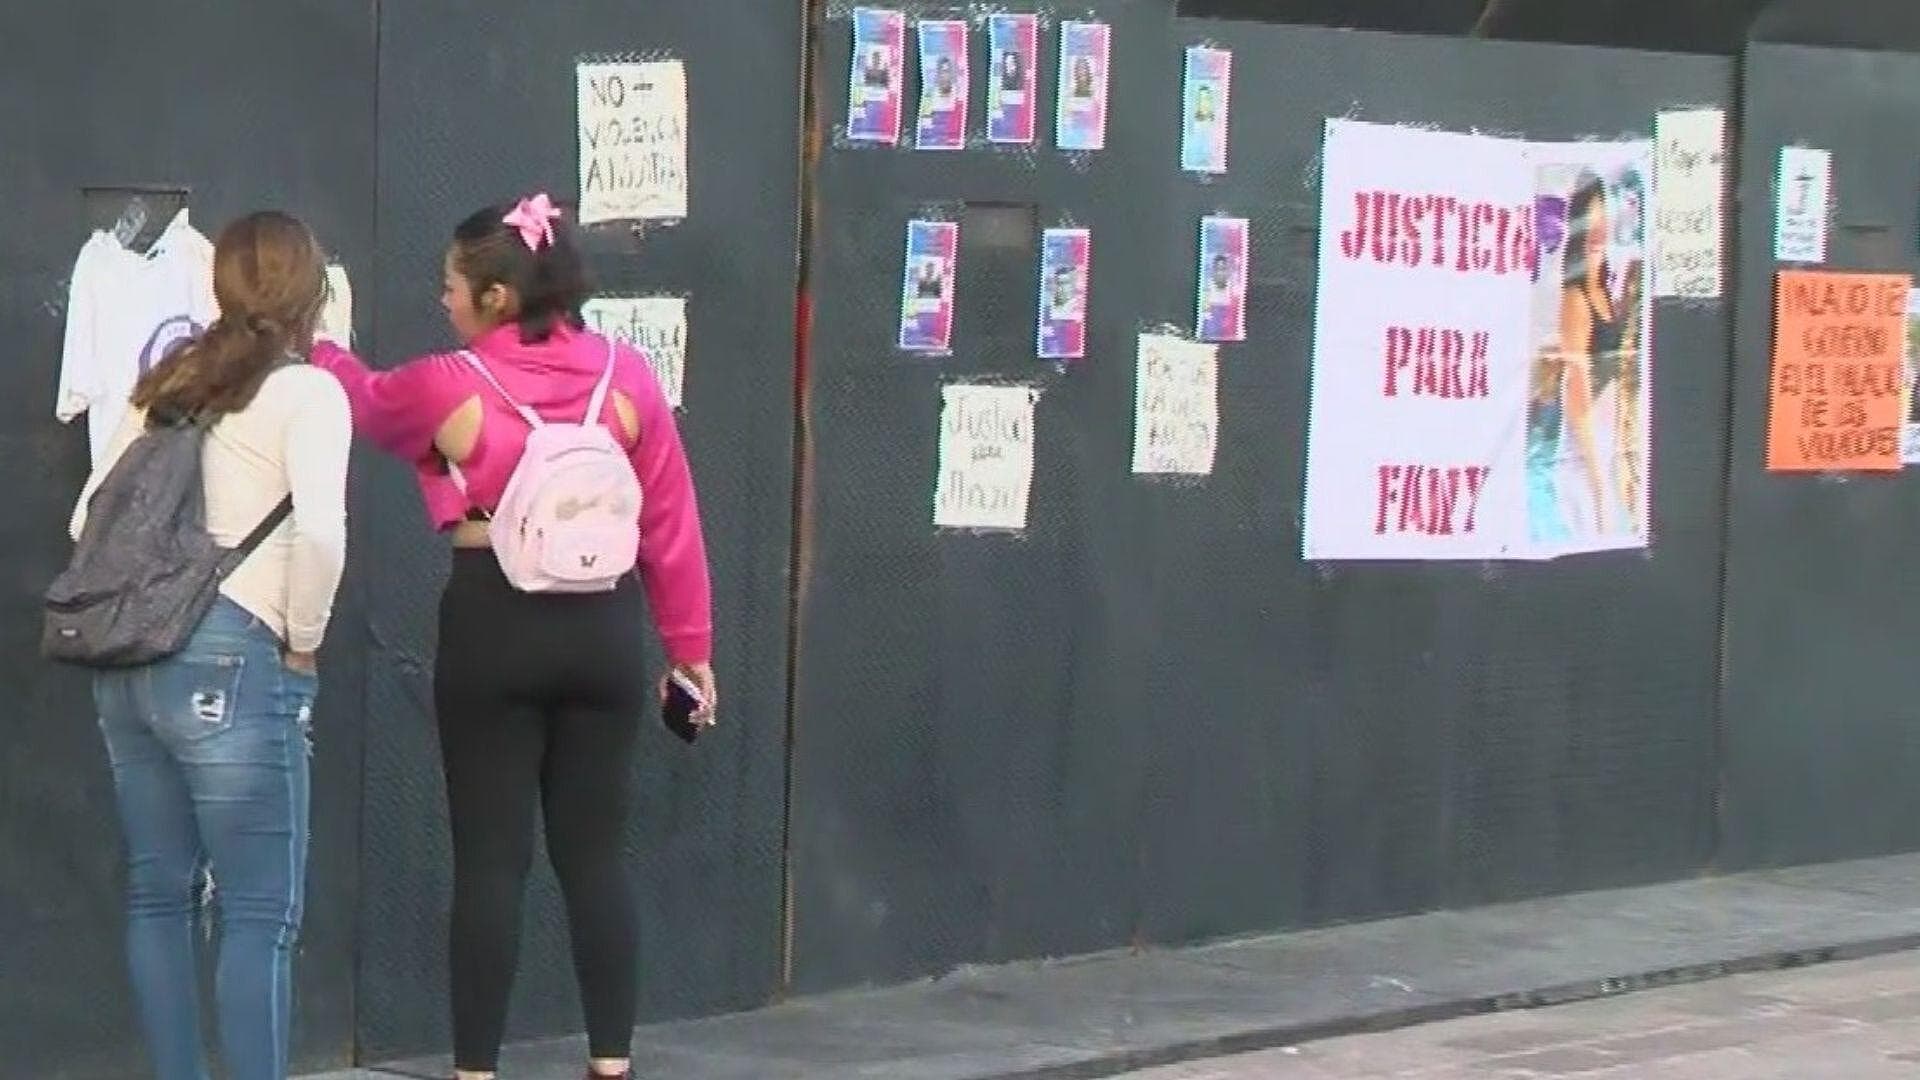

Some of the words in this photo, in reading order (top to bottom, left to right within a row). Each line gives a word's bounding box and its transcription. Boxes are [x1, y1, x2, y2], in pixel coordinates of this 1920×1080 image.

[590, 75, 624, 108] NO
[1340, 191, 1538, 274] JUSTICIA
[1382, 326, 1489, 399] PARA
[1374, 464, 1490, 536] FANY
